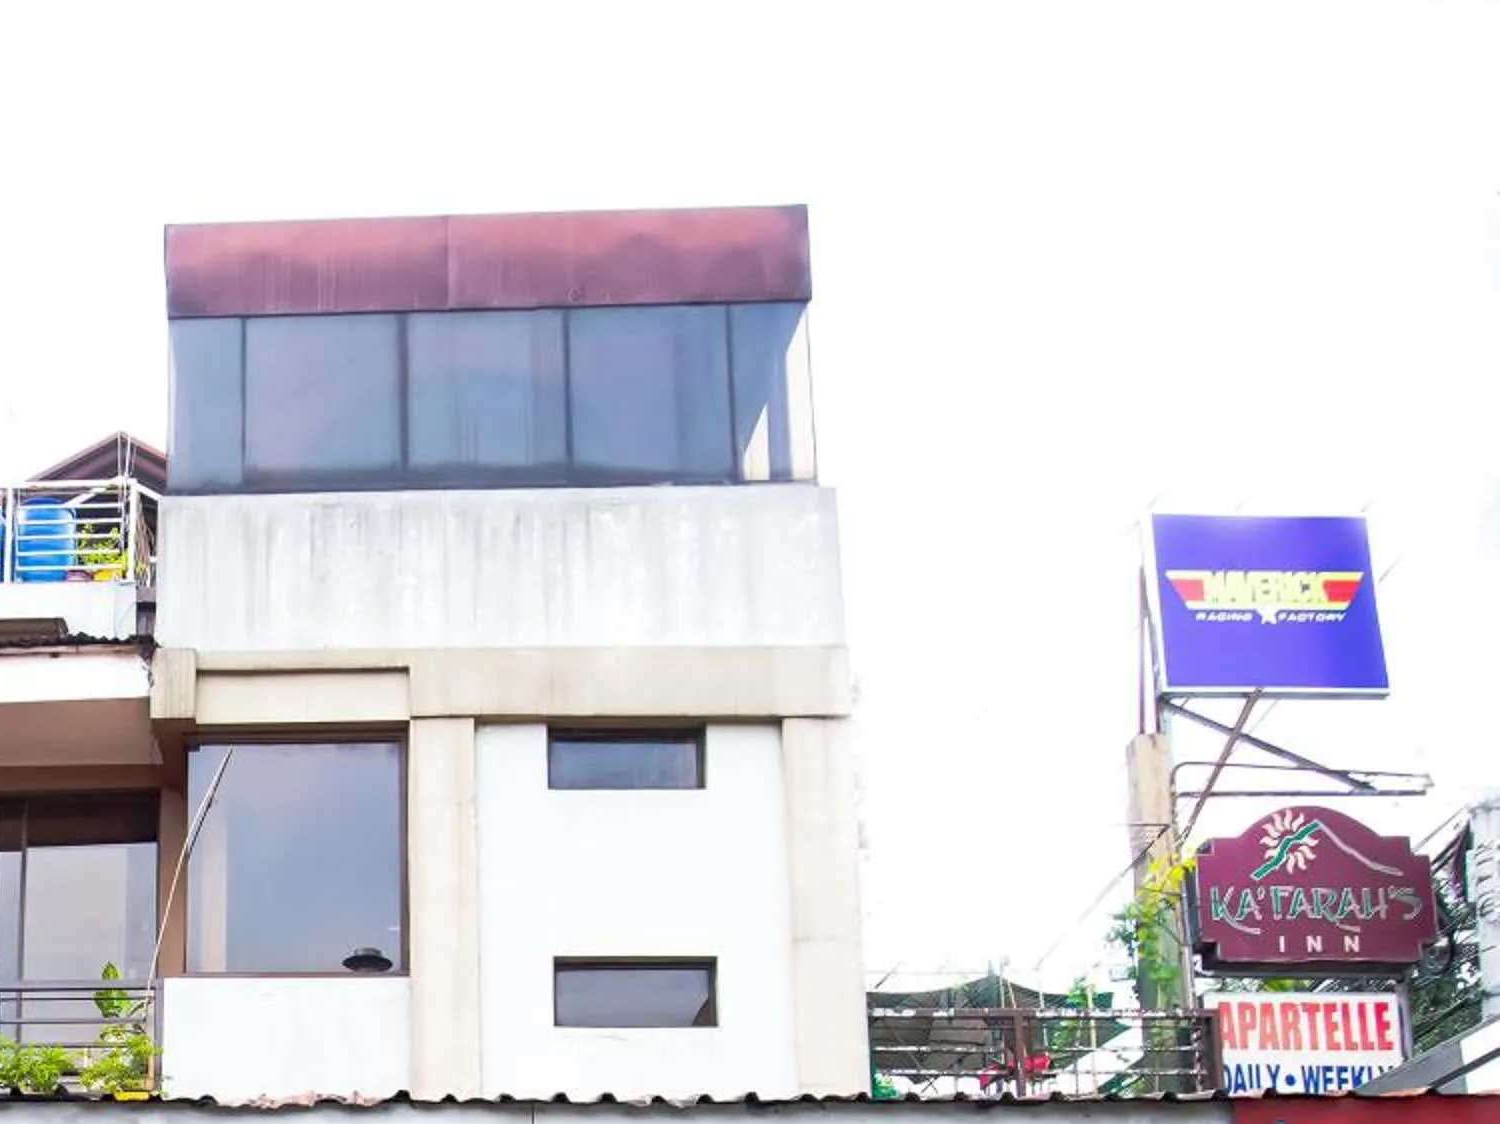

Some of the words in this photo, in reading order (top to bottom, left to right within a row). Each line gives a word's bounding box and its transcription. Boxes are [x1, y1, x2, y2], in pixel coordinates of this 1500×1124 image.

[1195, 611, 1253, 622] RACING
[1277, 611, 1347, 623] FACTORY
[1278, 935, 1360, 953] INN
[1218, 1001, 1394, 1052] APARTELLE
[1223, 1063, 1281, 1094] DAILY
